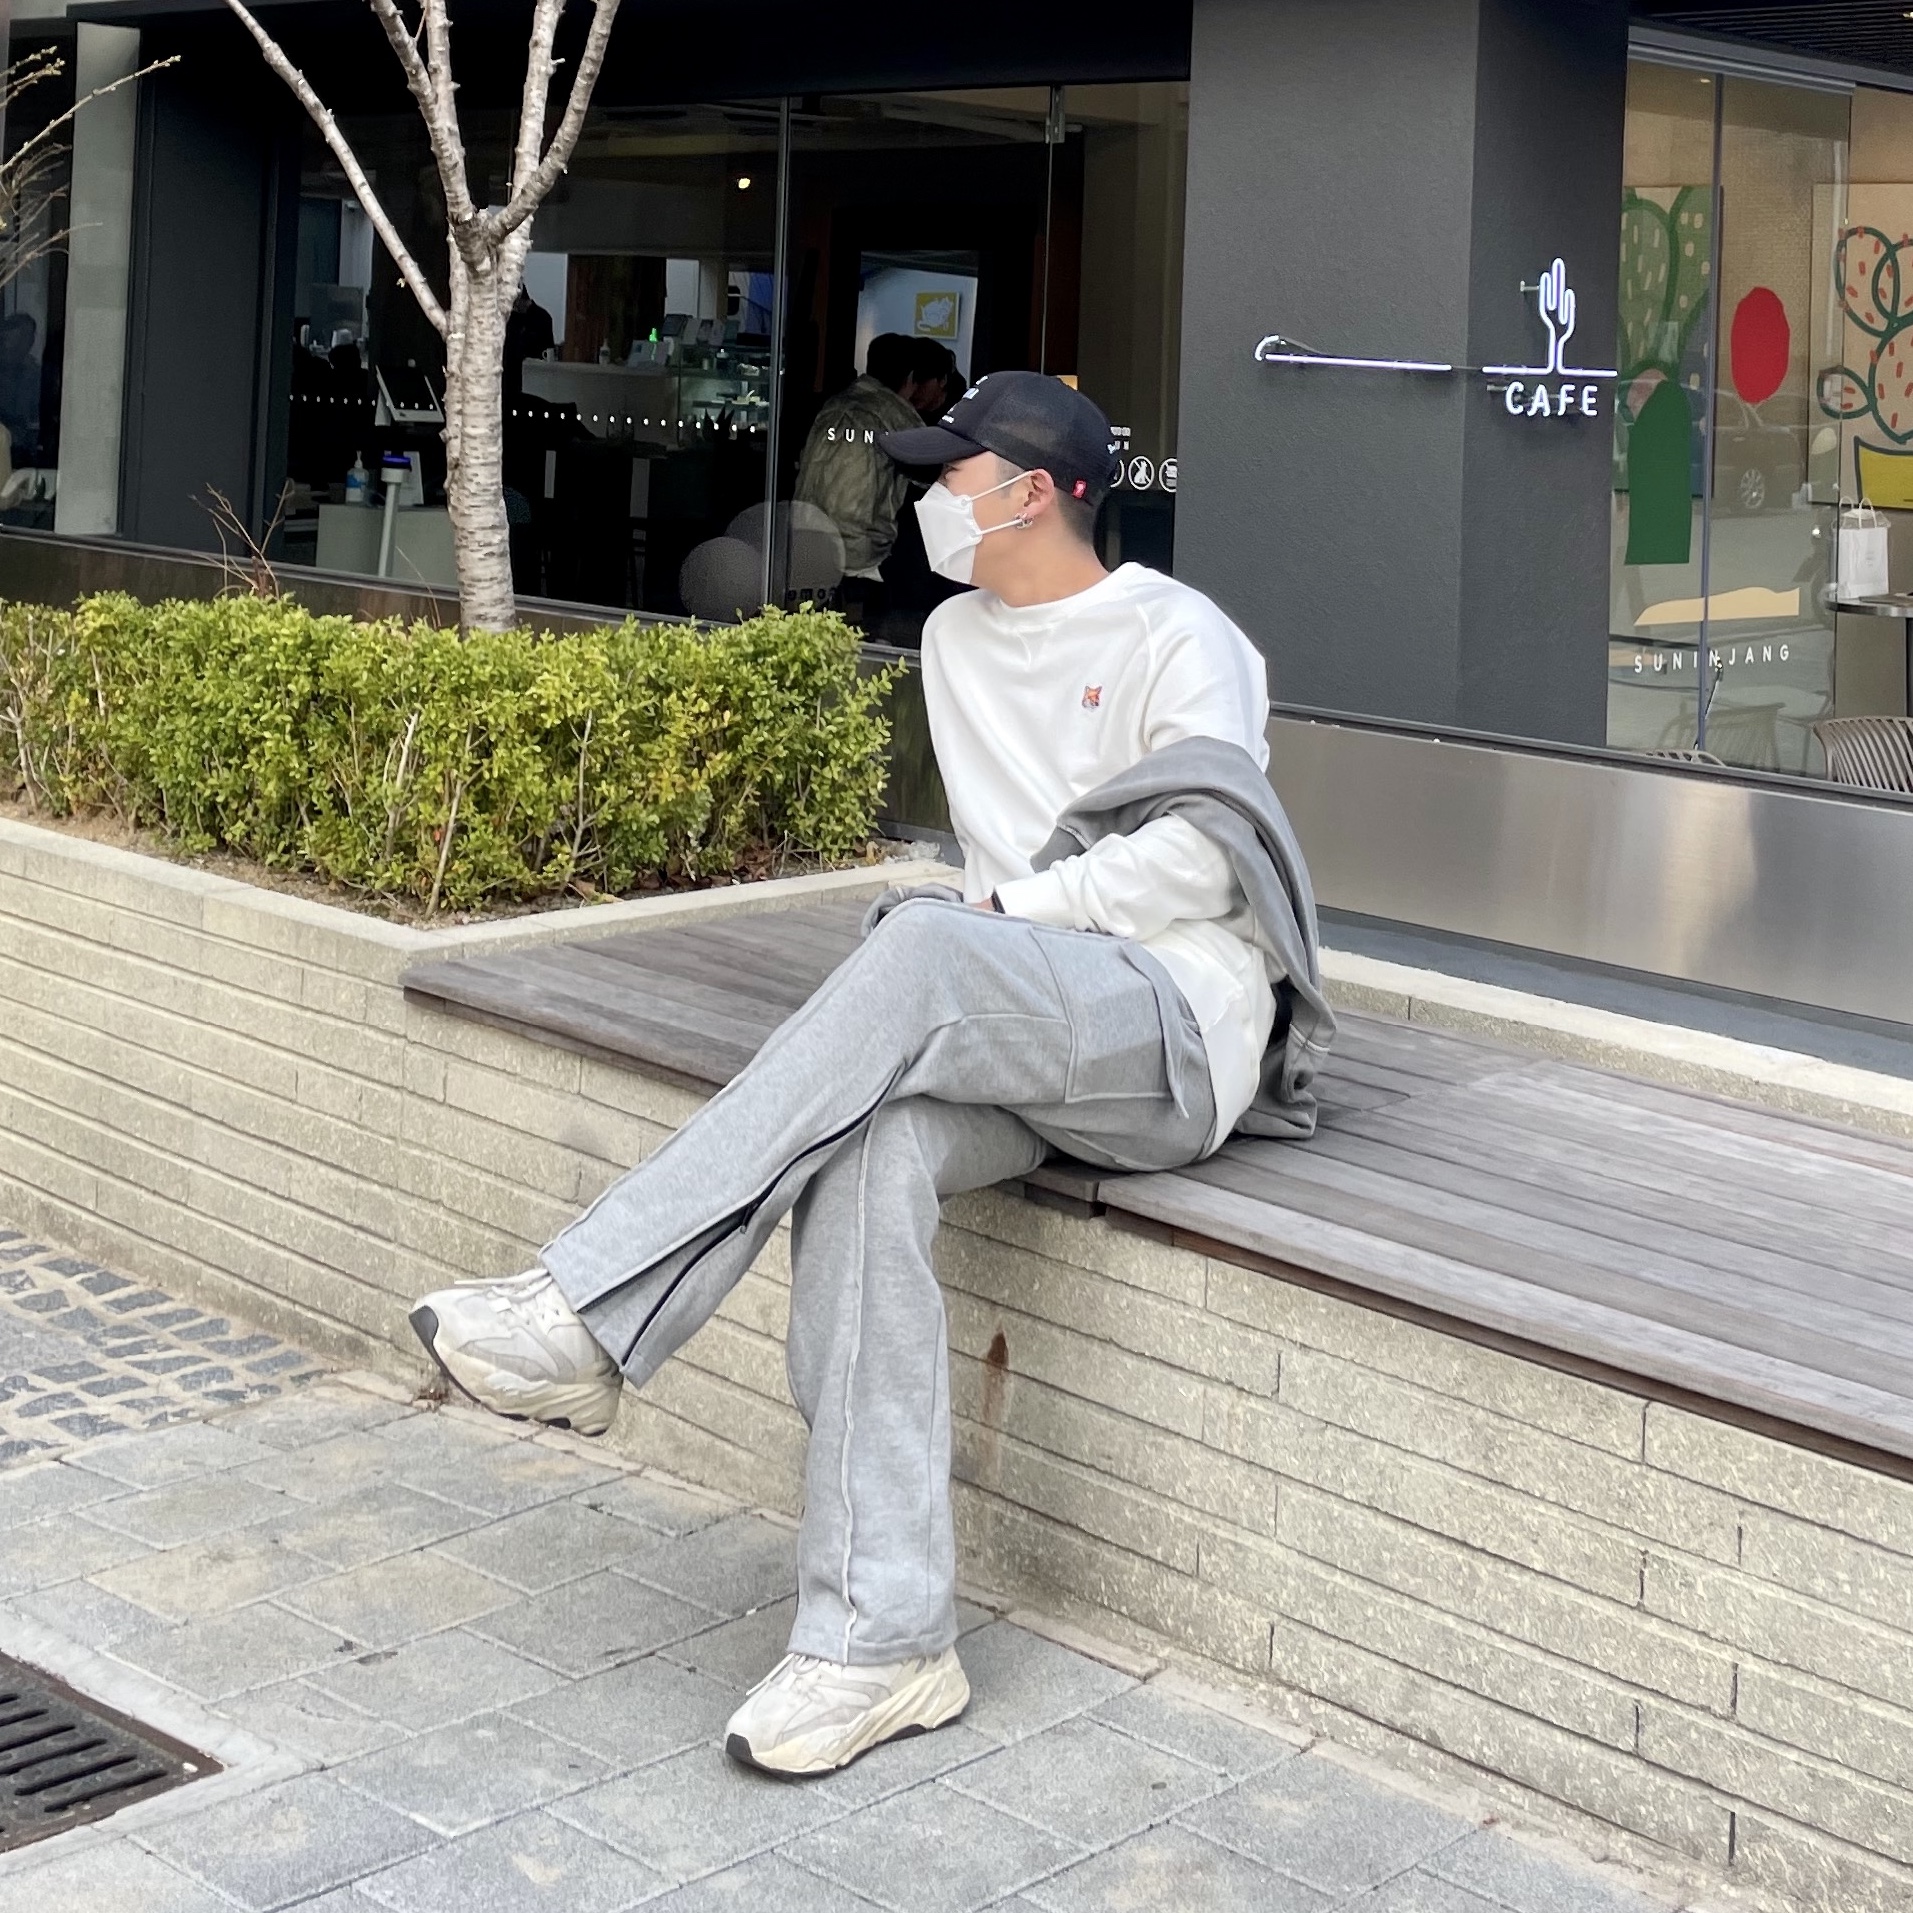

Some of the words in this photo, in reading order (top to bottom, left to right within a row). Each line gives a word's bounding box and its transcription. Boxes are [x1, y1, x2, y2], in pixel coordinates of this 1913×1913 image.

[1506, 381, 1598, 417] CAFE
[827, 427, 889, 444] SUN
[1634, 644, 1790, 673] SUNINJANG
